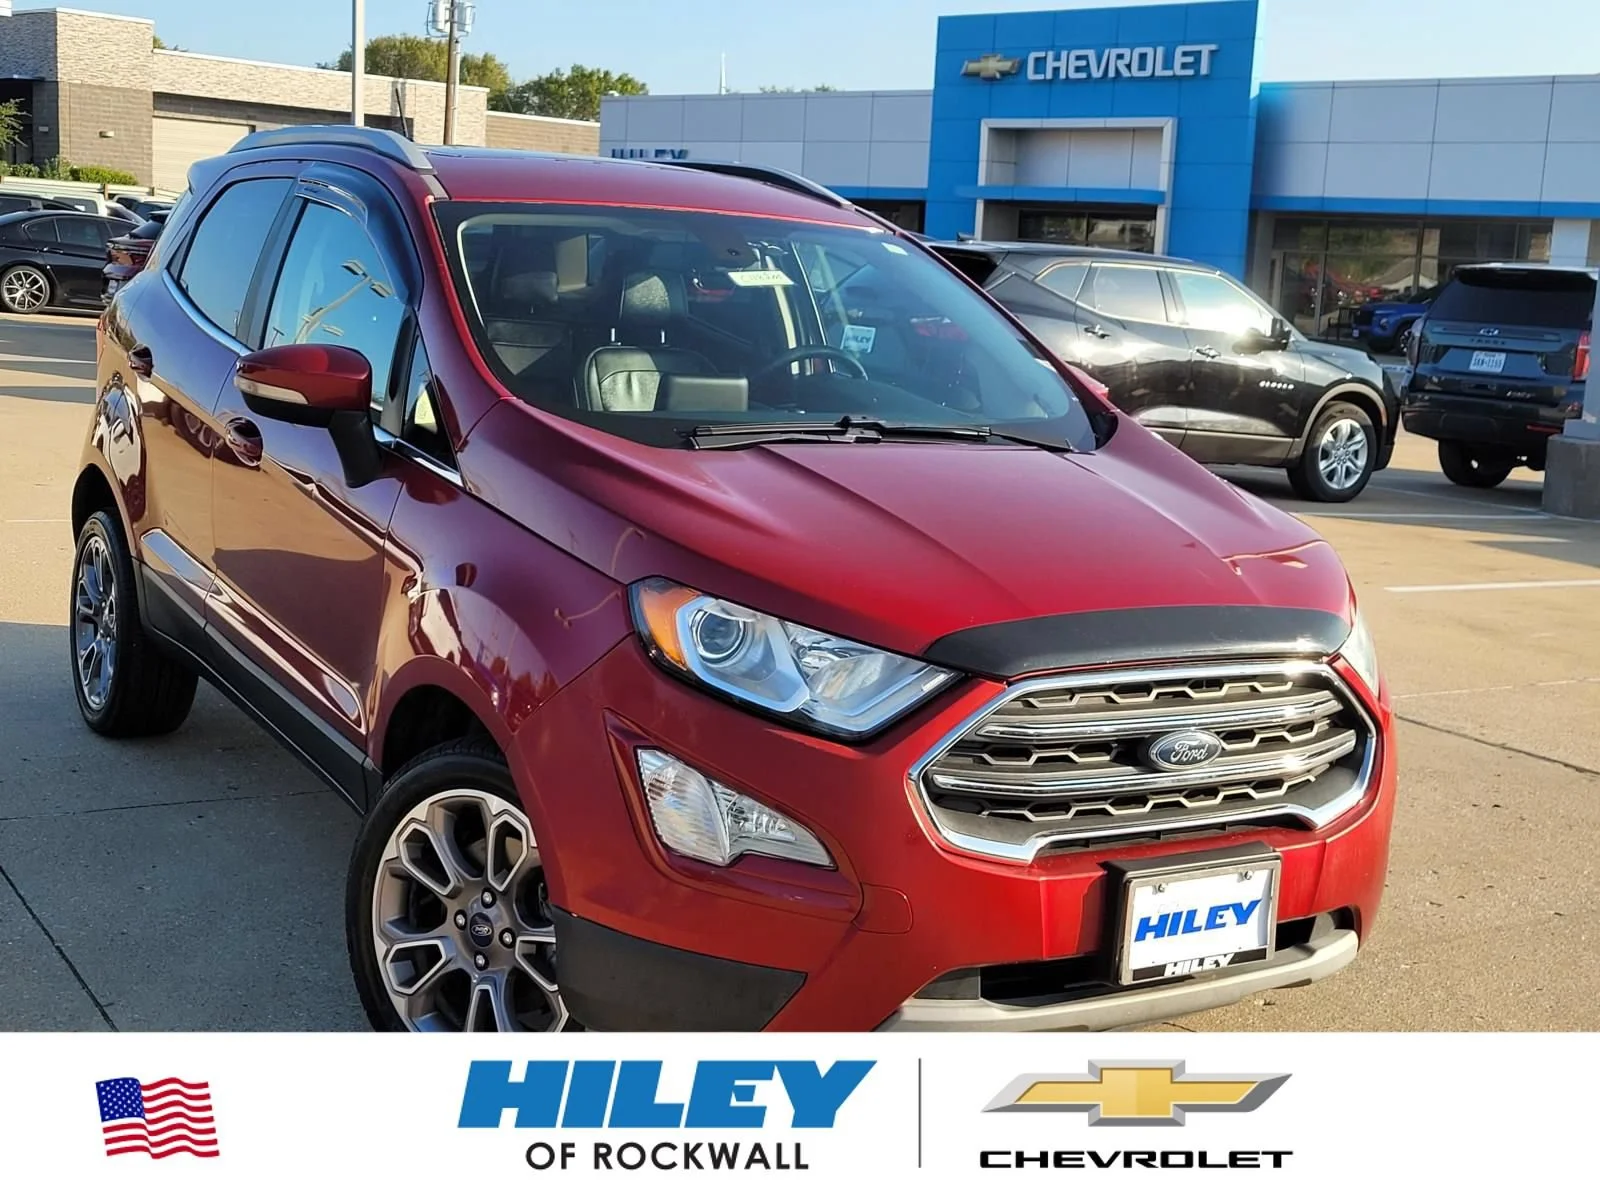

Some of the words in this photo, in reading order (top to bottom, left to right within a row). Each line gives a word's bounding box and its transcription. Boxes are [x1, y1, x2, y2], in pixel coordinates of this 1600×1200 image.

[1027, 44, 1219, 80] CHEVROLET
[1170, 740, 1209, 763] Ford
[1134, 898, 1262, 942] HILEY
[1164, 952, 1235, 976] HILEY
